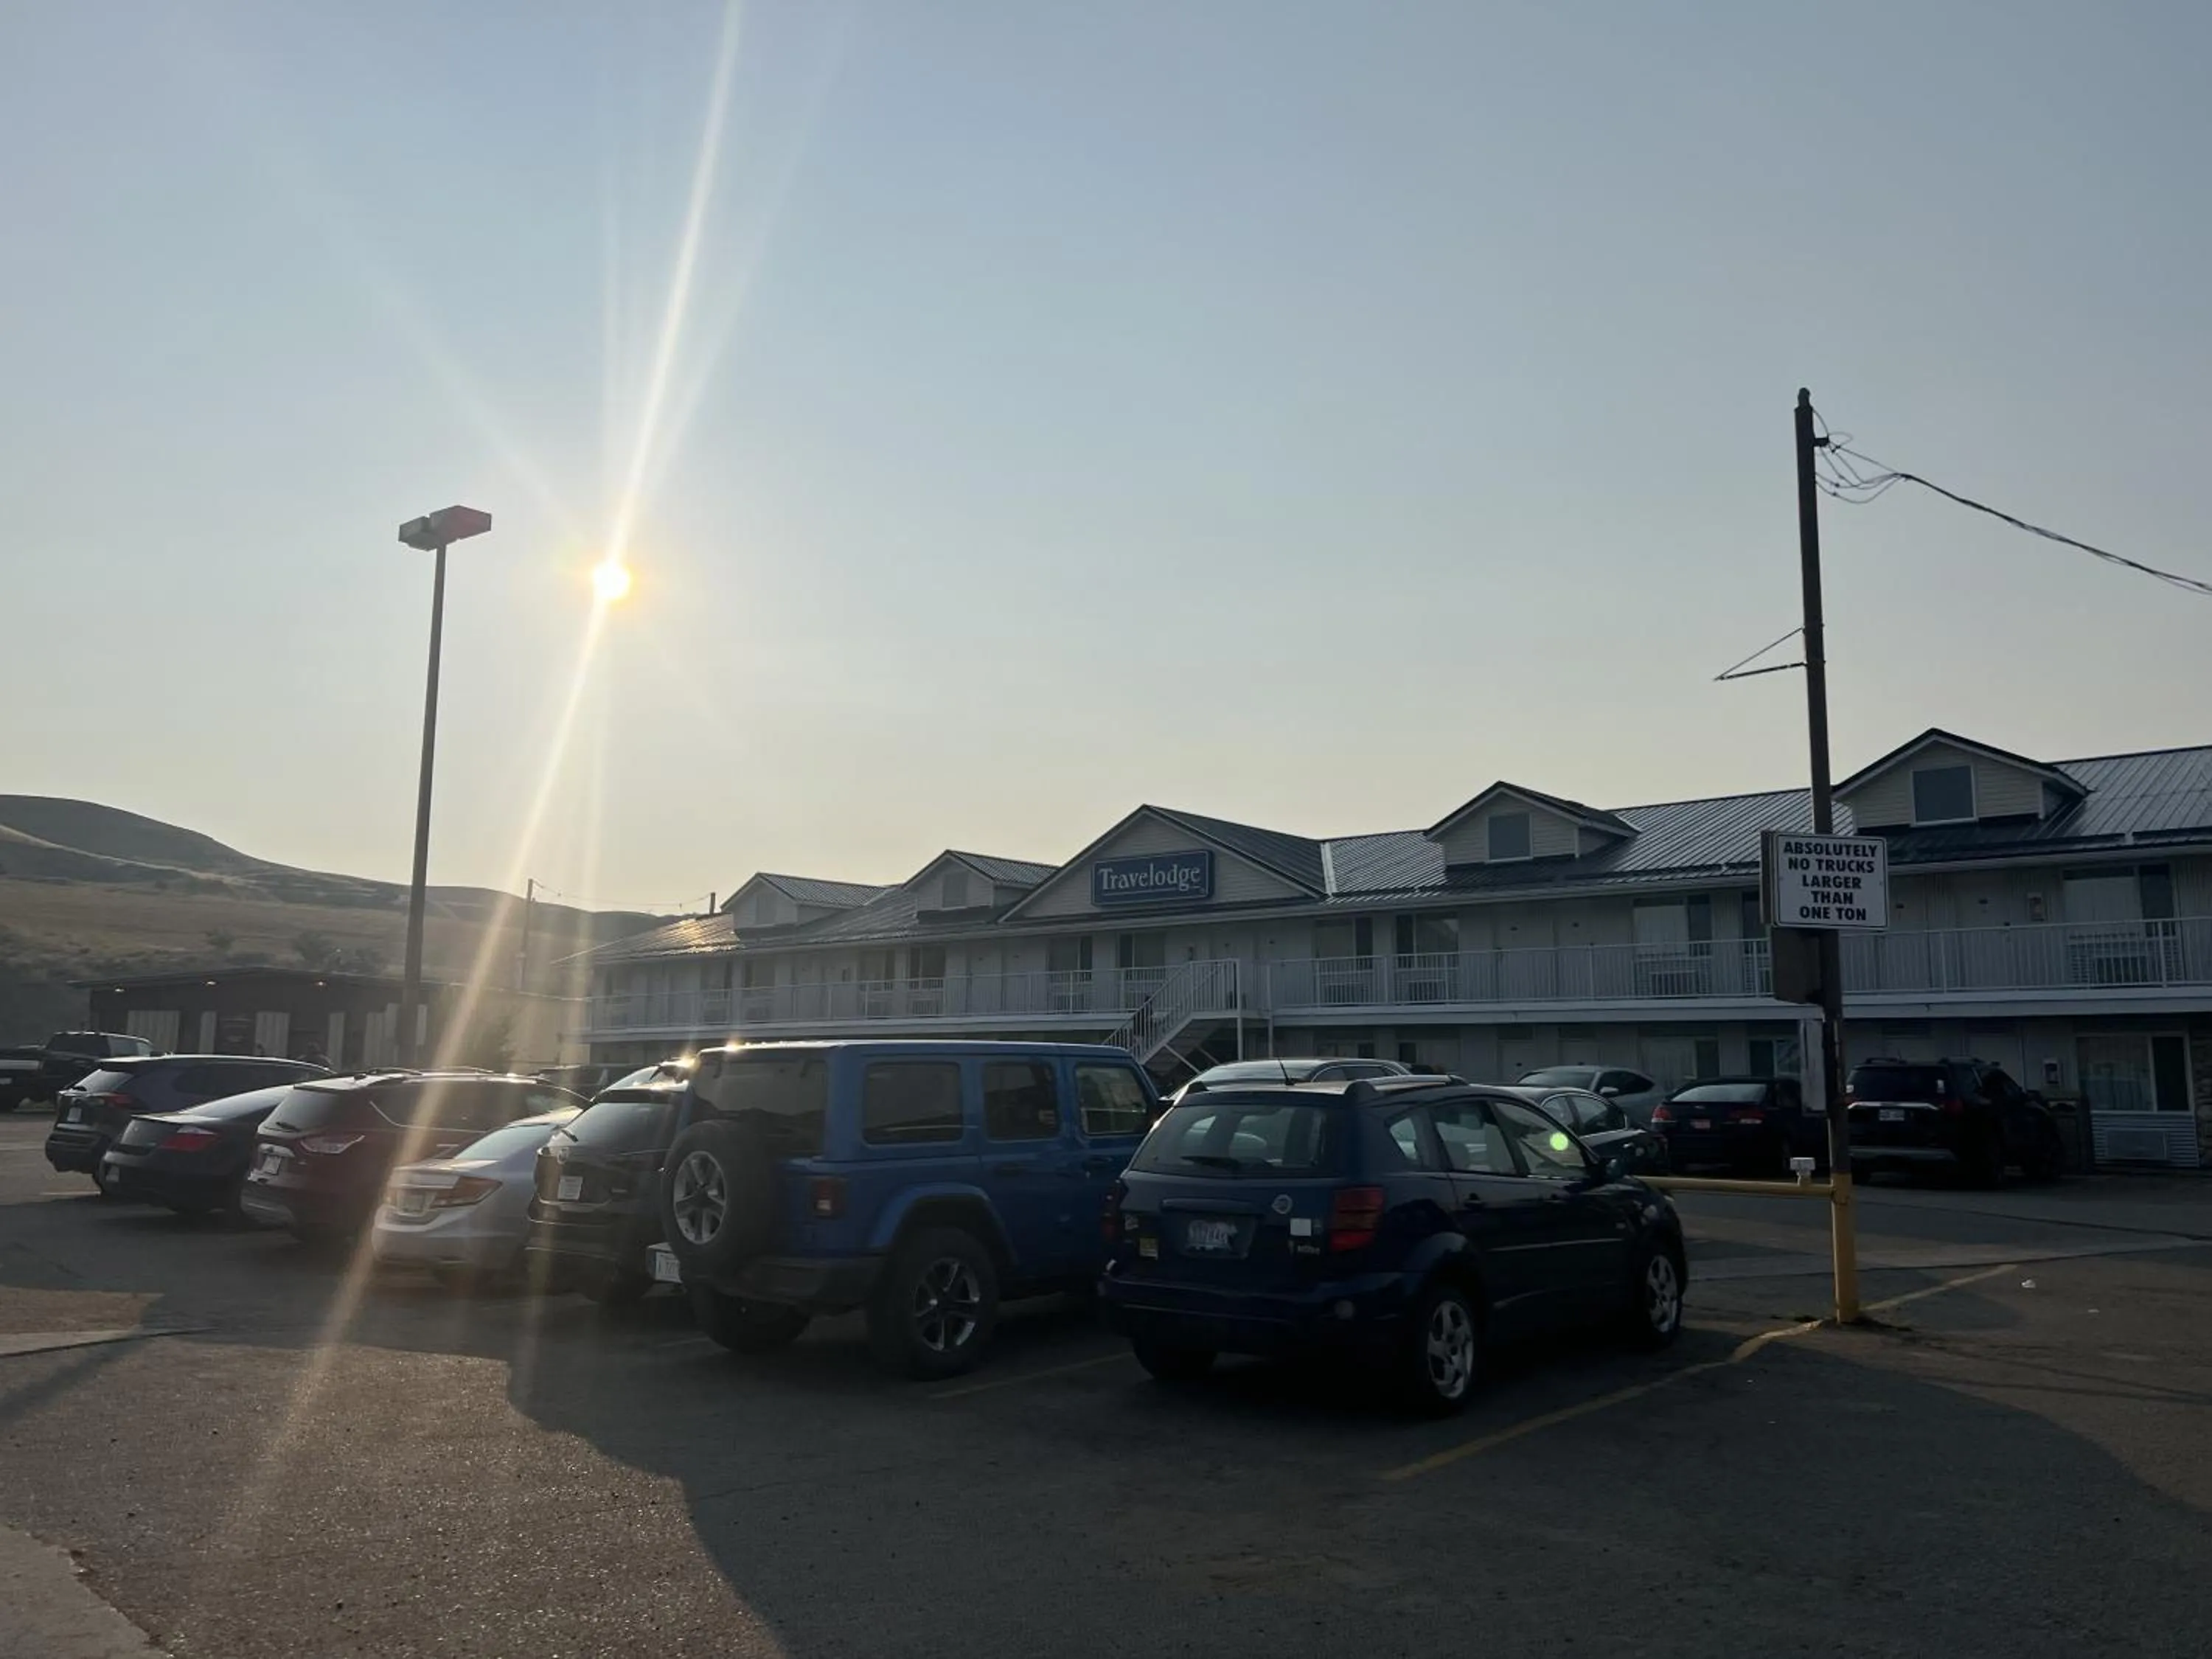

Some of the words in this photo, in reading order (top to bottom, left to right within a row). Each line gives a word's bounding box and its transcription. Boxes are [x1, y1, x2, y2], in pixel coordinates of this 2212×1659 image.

[1784, 842, 1877, 857] ABSOLUTELY
[1789, 858, 1810, 870] NO
[1815, 858, 1874, 873] TRUCKS
[1099, 863, 1200, 891] Travelodge
[1802, 874, 1862, 889] LARGER
[1811, 891, 1853, 904] THAN
[1800, 906, 1831, 919] ONE
[1835, 908, 1866, 920] TON
